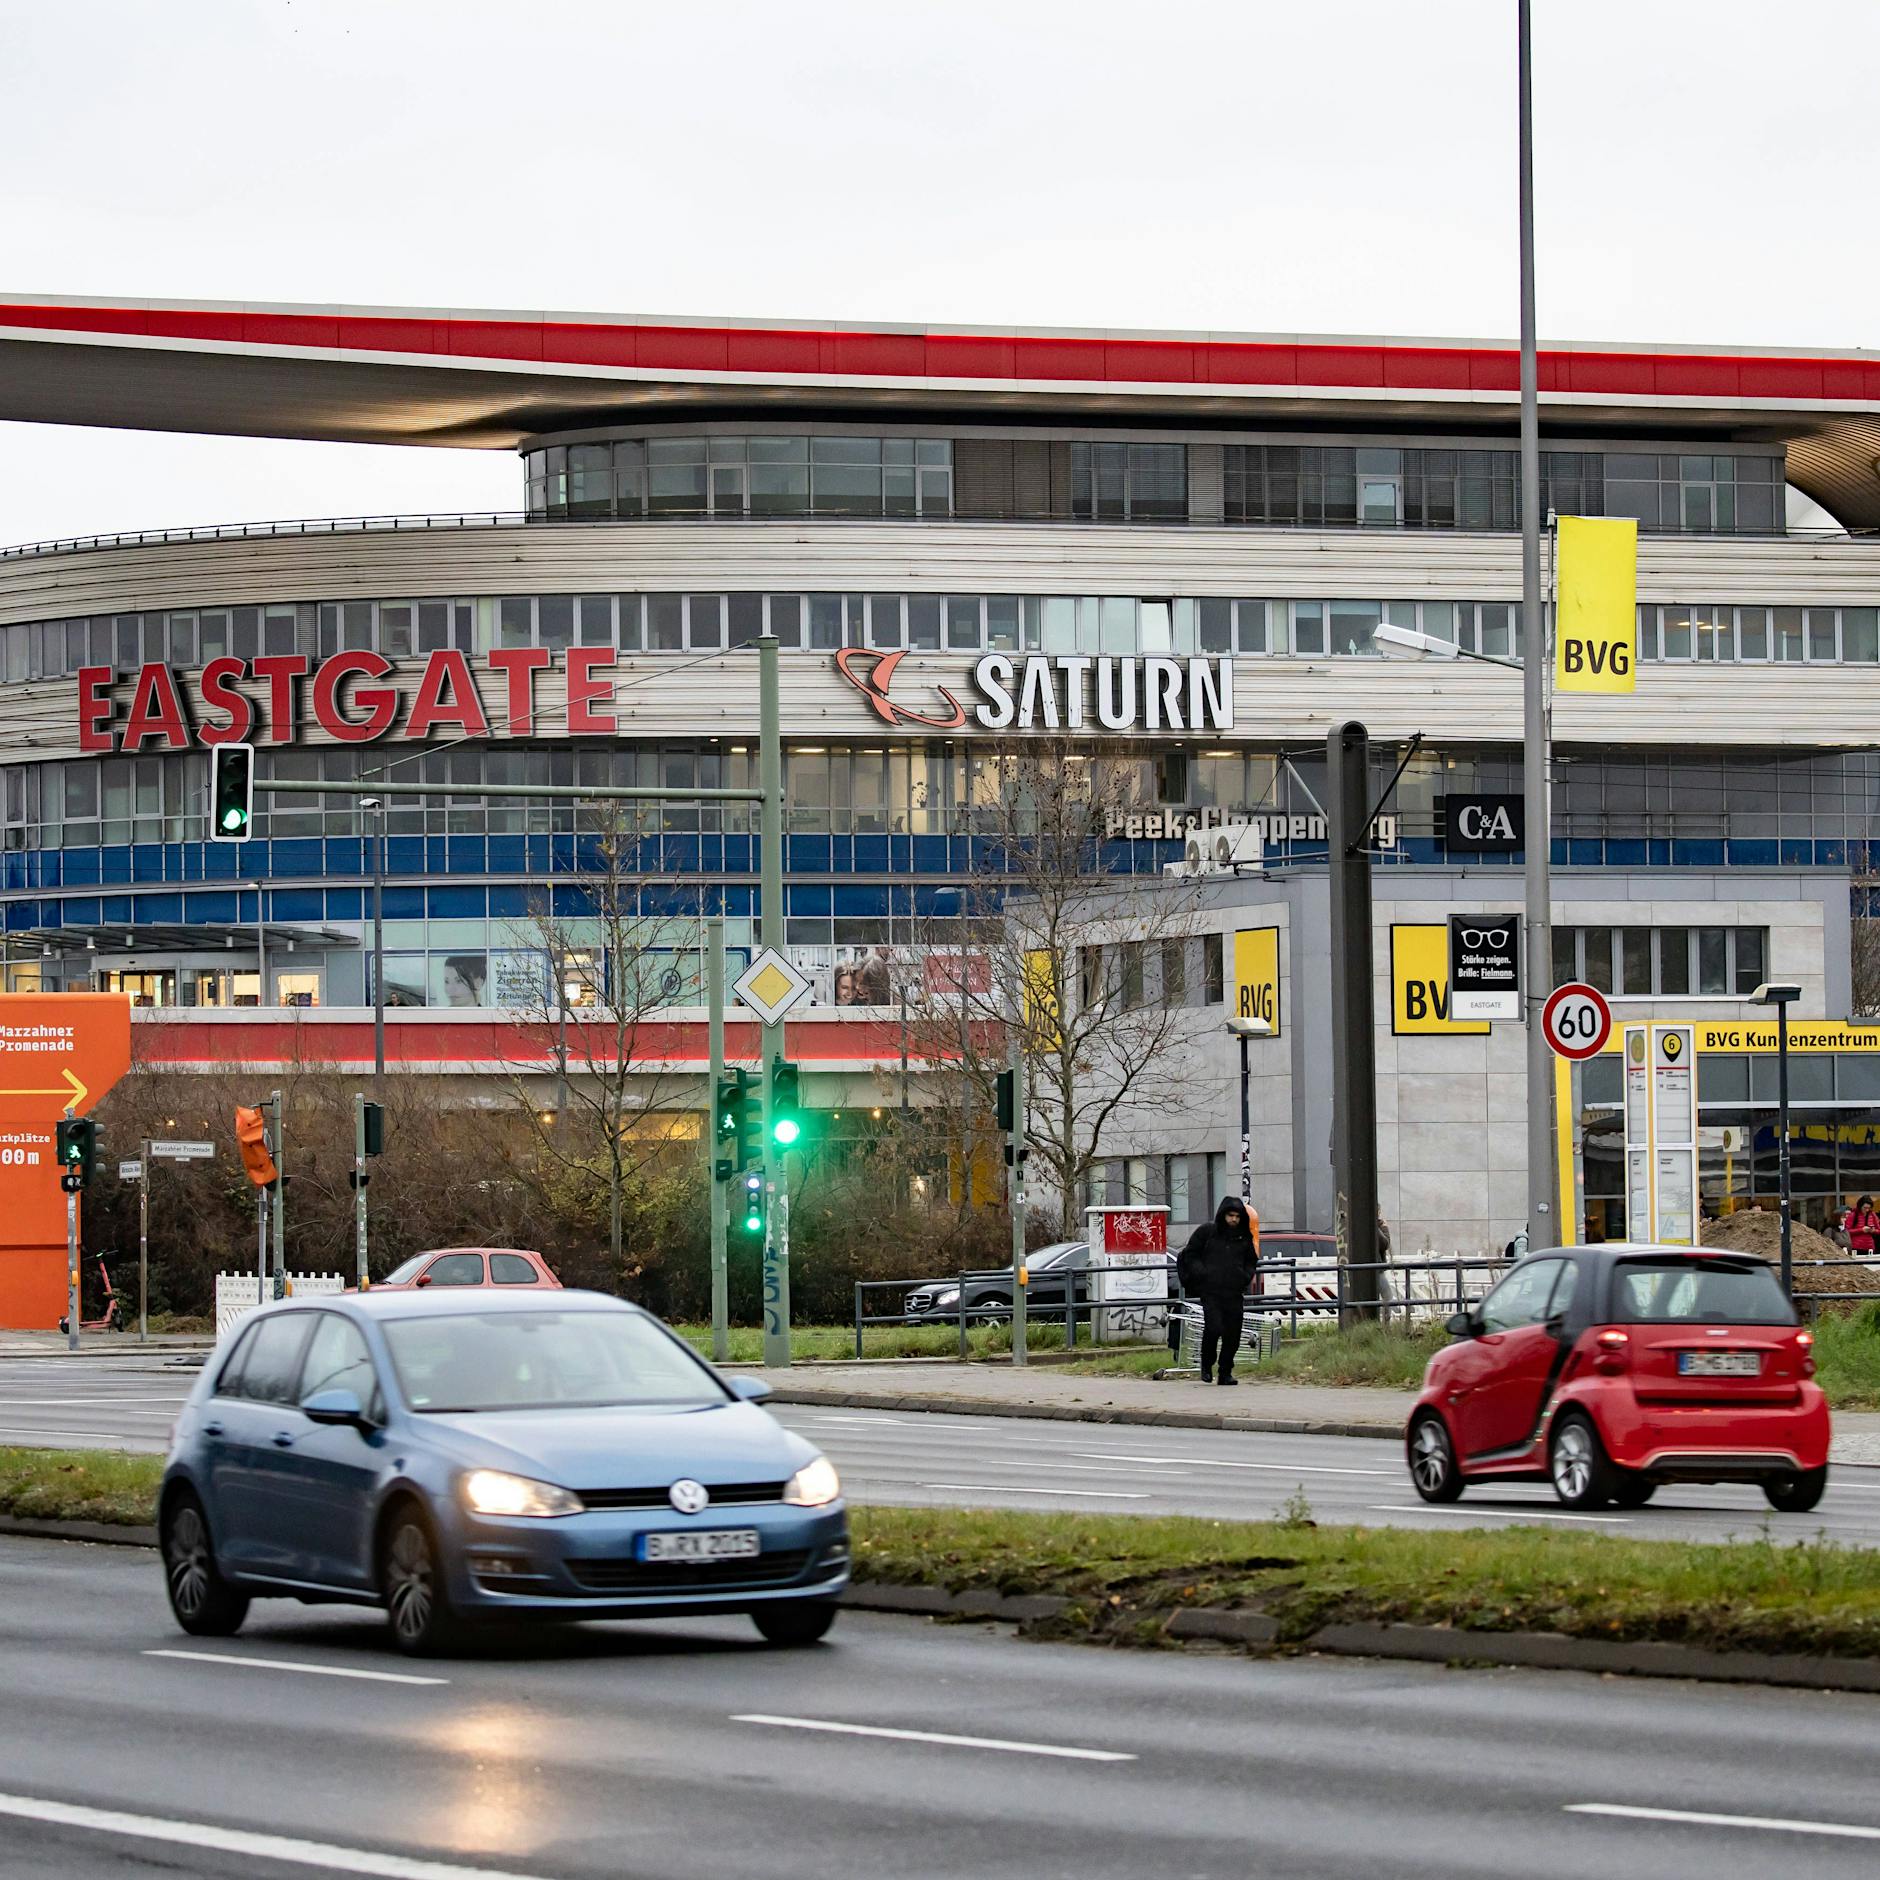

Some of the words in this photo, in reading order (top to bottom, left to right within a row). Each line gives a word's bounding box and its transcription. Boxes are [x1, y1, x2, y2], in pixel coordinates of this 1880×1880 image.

[1564, 639, 1629, 676] BVG
[78, 646, 617, 753] EASTGATE
[974, 654, 1234, 730] SATURN
[1458, 805, 1517, 840] C&A
[1461, 954, 1485, 965] Stärke
[1486, 955, 1512, 965] zeigen.
[1458, 968, 1480, 978] Brille:
[1481, 968, 1516, 978] Fielmann.
[1240, 982, 1273, 1022] BVG
[1406, 980, 1448, 1020] BV
[1470, 1001, 1503, 1009] EASTGATE
[1558, 1005, 1596, 1040] 60
[0, 1024, 74, 1037] Marzahner
[0, 1038, 74, 1051] Promenade
[1668, 1038, 1675, 1050] 6
[1706, 1032, 1740, 1047] BVG
[1746, 1032, 1878, 1047] Kunenzentrum
[0, 1133, 51, 1145] rkplätze
